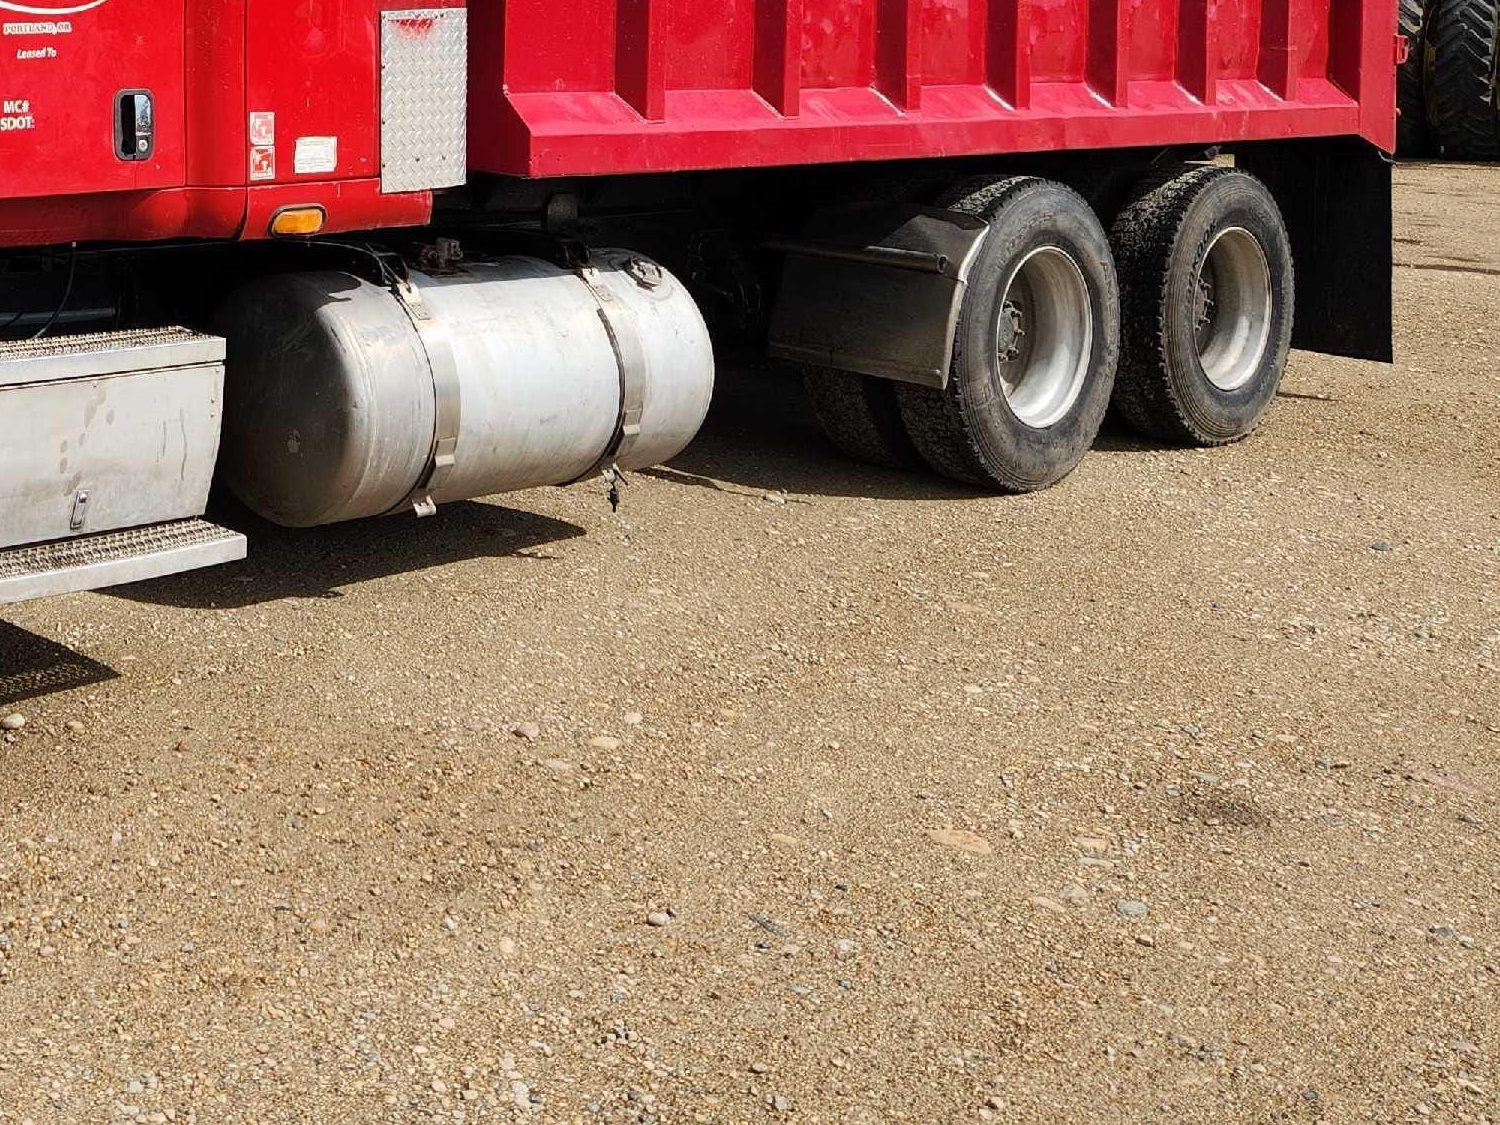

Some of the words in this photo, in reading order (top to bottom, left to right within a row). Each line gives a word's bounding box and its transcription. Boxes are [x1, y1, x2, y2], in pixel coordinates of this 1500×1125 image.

[17, 46, 47, 59] Leased
[47, 46, 57, 58] To
[3, 99, 29, 114] MC#
